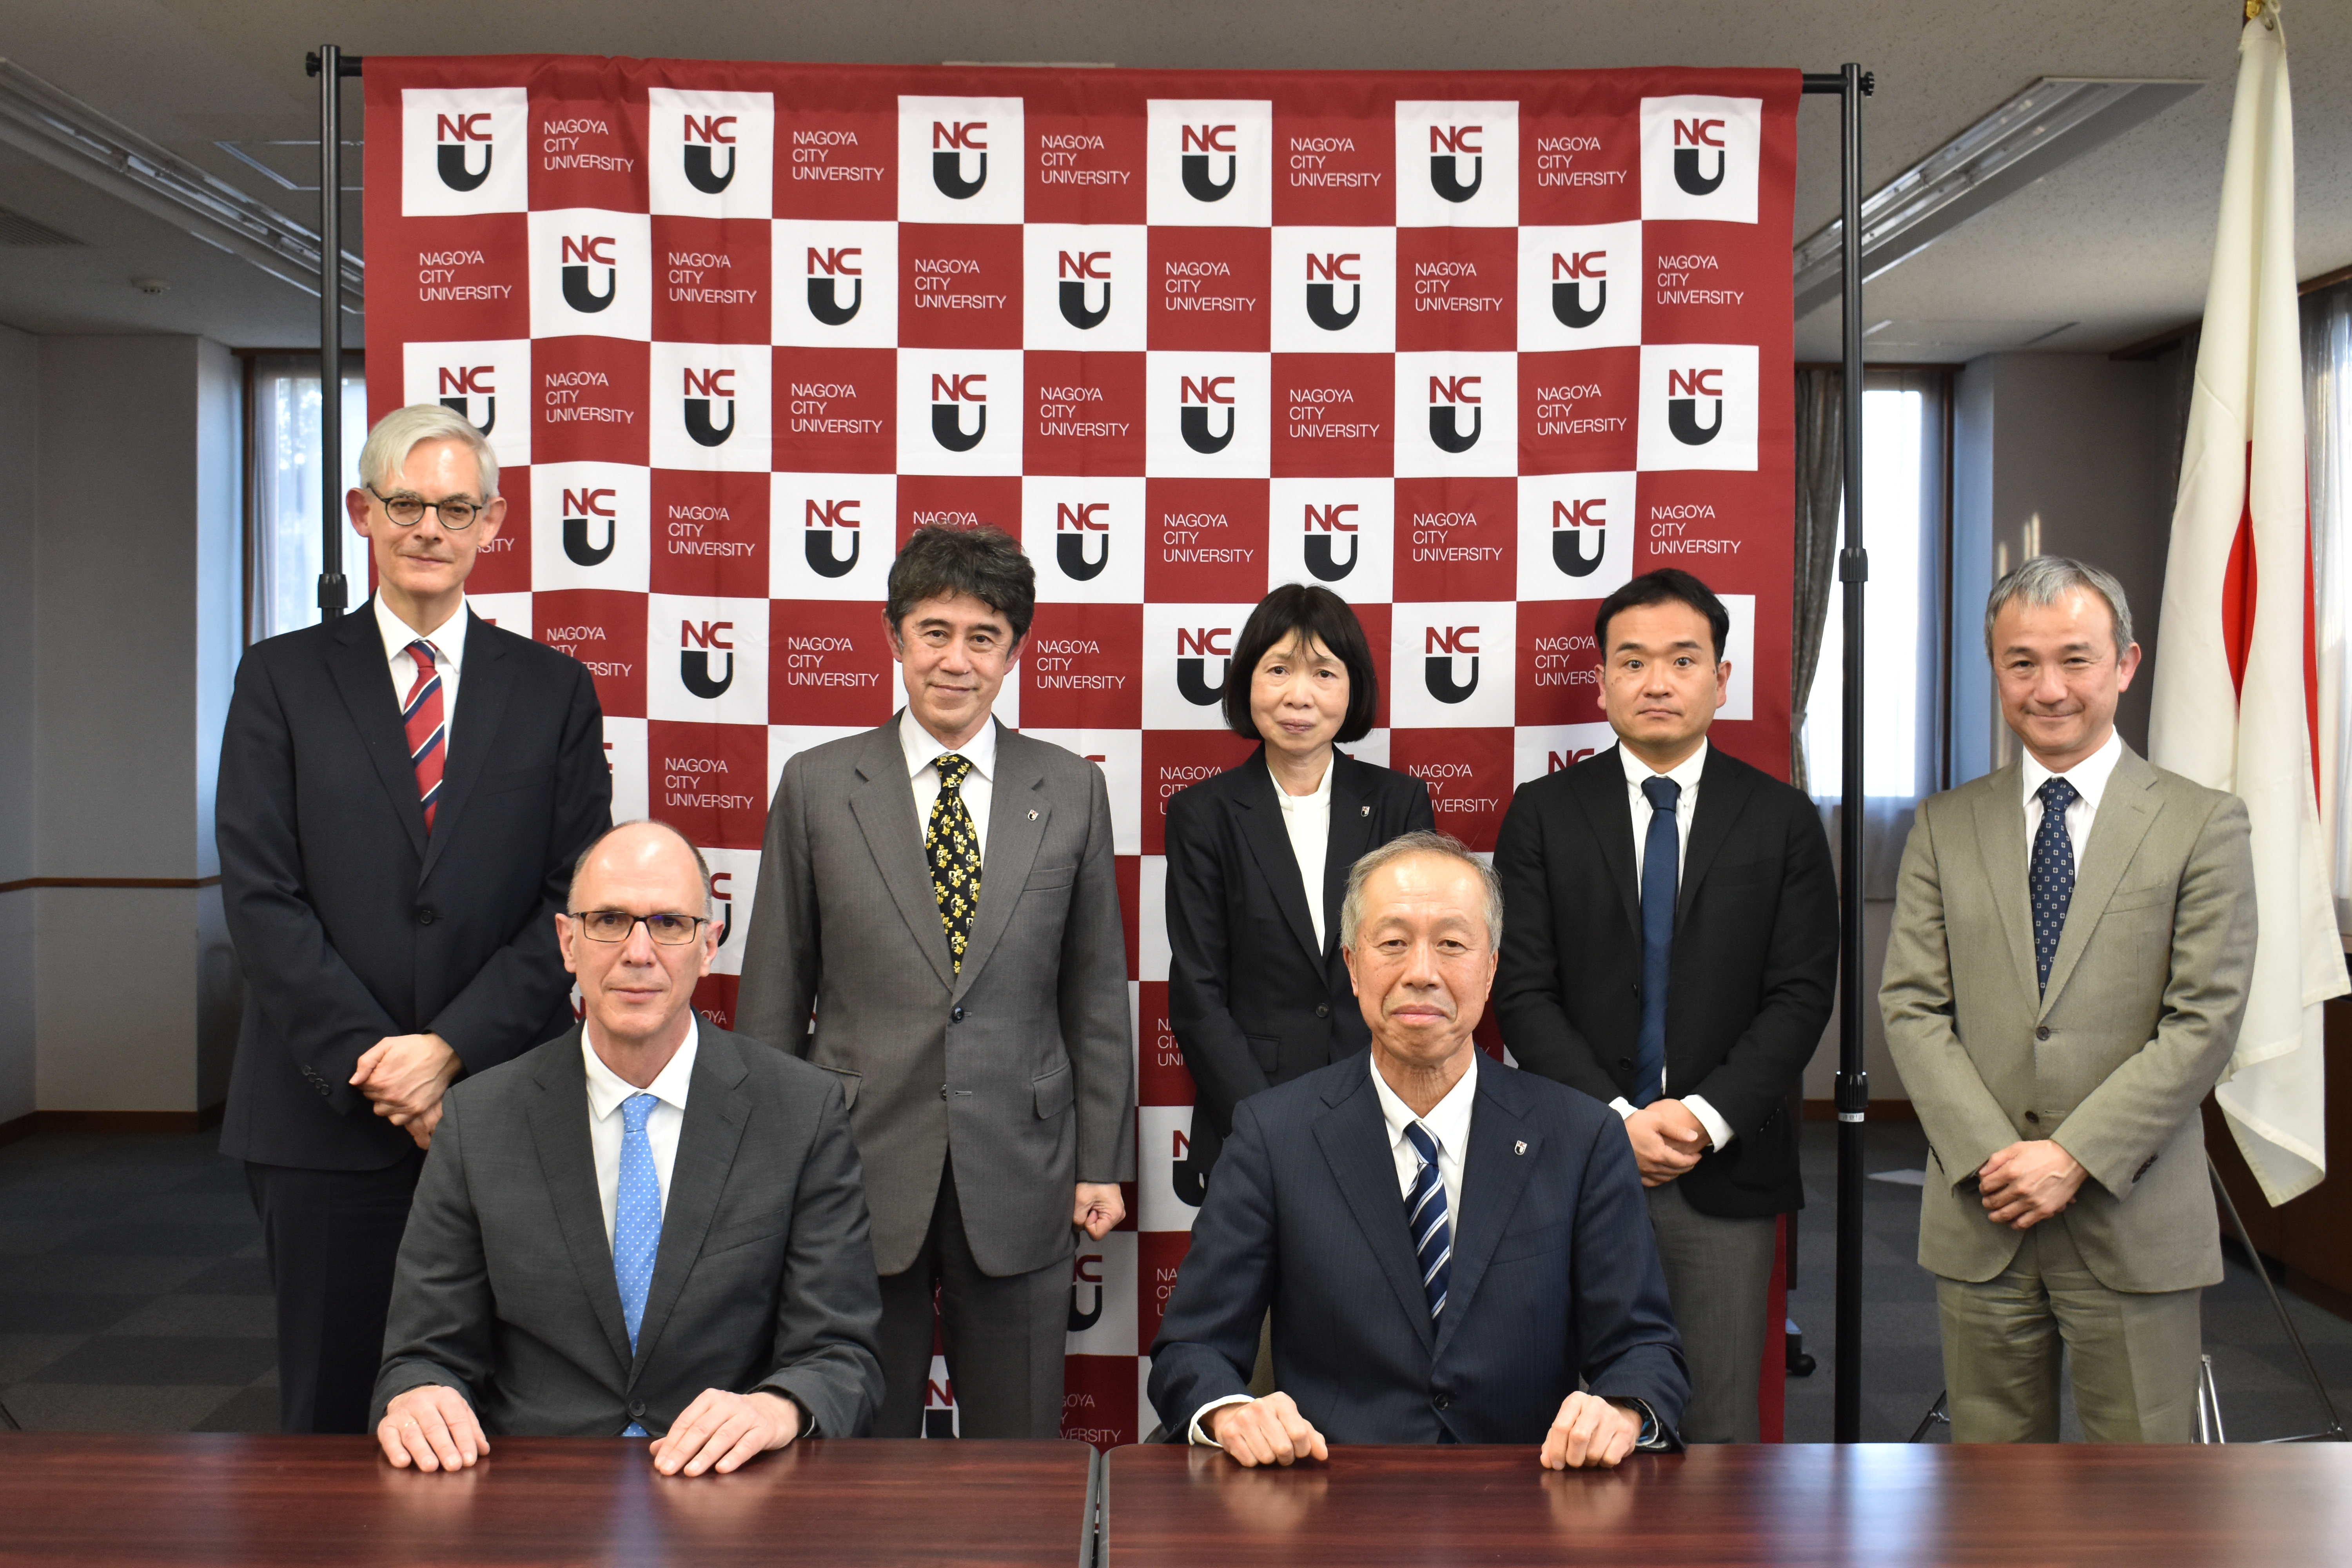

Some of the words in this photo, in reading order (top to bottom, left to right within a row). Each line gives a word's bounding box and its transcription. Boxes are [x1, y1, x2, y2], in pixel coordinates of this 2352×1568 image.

[544, 118, 609, 135] NAGOYA
[544, 137, 579, 153] CITY
[793, 131, 858, 145] NAGOYA
[1042, 134, 1105, 150] NAGOYA
[1290, 137, 1355, 152] NAGOYA
[1537, 136, 1601, 152] NAGOYA
[544, 154, 634, 172] UNIVERSITY
[792, 148, 829, 163] CITY
[1041, 152, 1077, 166] CITY
[1290, 154, 1326, 169] CITY
[1537, 154, 1573, 169] CITY
[792, 166, 884, 181] UNIVERSITY
[1041, 170, 1131, 185] UNIVERSITY
[1290, 172, 1381, 187] UNIVERSITY
[1538, 170, 1627, 187] UNIVERSITY
[419, 250, 485, 266] NAGOYA
[668, 252, 731, 268] NAGOYA
[1658, 255, 1719, 269] NAGOYA
[915, 259, 980, 274] NAGOYA
[1166, 261, 1230, 276] NAGOYA
[1416, 261, 1477, 276] NAGOYA
[419, 269, 455, 284] CITY
[669, 269, 704, 284] CITY
[915, 276, 951, 290] CITY
[1657, 273, 1690, 287] CITY
[419, 285, 512, 301] UNIVERSITY
[1165, 279, 1201, 293] CITY
[1415, 279, 1450, 294] CITY
[669, 288, 757, 304] UNIVERSITY
[915, 294, 1007, 309] UNIVERSITY
[1657, 290, 1744, 305] UNIVERSITY
[1165, 297, 1256, 312] UNIVERSITY
[1415, 297, 1503, 312] UNIVERSITY
[546, 371, 609, 387] NAGOYA
[546, 390, 579, 405] CITY
[791, 383, 857, 398] NAGOYA
[1041, 387, 1103, 401] NAGOYA
[1290, 388, 1354, 403] NAGOYA
[1537, 383, 1602, 401] NAGOYA
[791, 400, 827, 415] CITY
[1040, 404, 1076, 418] CITY
[1289, 406, 1325, 420] CITY
[1537, 403, 1573, 419] CITY
[546, 407, 634, 424] UNIVERSITY
[791, 418, 883, 434] UNIVERSITY
[1040, 422, 1129, 437] UNIVERSITY
[1290, 424, 1380, 438] UNIVERSITY
[1537, 417, 1627, 436] UNIVERSITY
[669, 505, 730, 521] NAGOYA
[913, 511, 978, 525] NAGOYA
[1414, 512, 1477, 527] NAGOYA
[1651, 505, 1716, 520] NAGOYA
[1164, 513, 1228, 528] NAGOYA
[668, 522, 704, 537] CITY
[1413, 530, 1448, 544] CITY
[1650, 522, 1686, 537] CITY
[1163, 531, 1199, 545] CITY
[668, 540, 755, 556] UNIVERSITY
[1413, 547, 1503, 562] UNIVERSITY
[1650, 539, 1741, 555] UNIVERSITY
[1163, 548, 1254, 563] UNIVERSITY
[547, 626, 606, 641] NAGOYA
[788, 637, 853, 652] NAGOYA
[1037, 640, 1100, 654] NAGOYA
[1536, 636, 1595, 651] NAGOYA
[788, 654, 824, 668] CITY
[1036, 657, 1073, 671] CITY
[1535, 654, 1570, 668] CITY
[788, 672, 879, 687] UNIVERSITY
[1037, 675, 1126, 689] UNIVERSITY
[1535, 670, 1598, 686] UNIVERS
[665, 757, 728, 773] NAGOYA
[1409, 764, 1473, 777] NAGOYA
[665, 775, 701, 789] CITY
[1160, 784, 1188, 797] CIT
[666, 793, 754, 809] UNIVERSITY
[1432, 799, 1499, 812] IVERSITY
